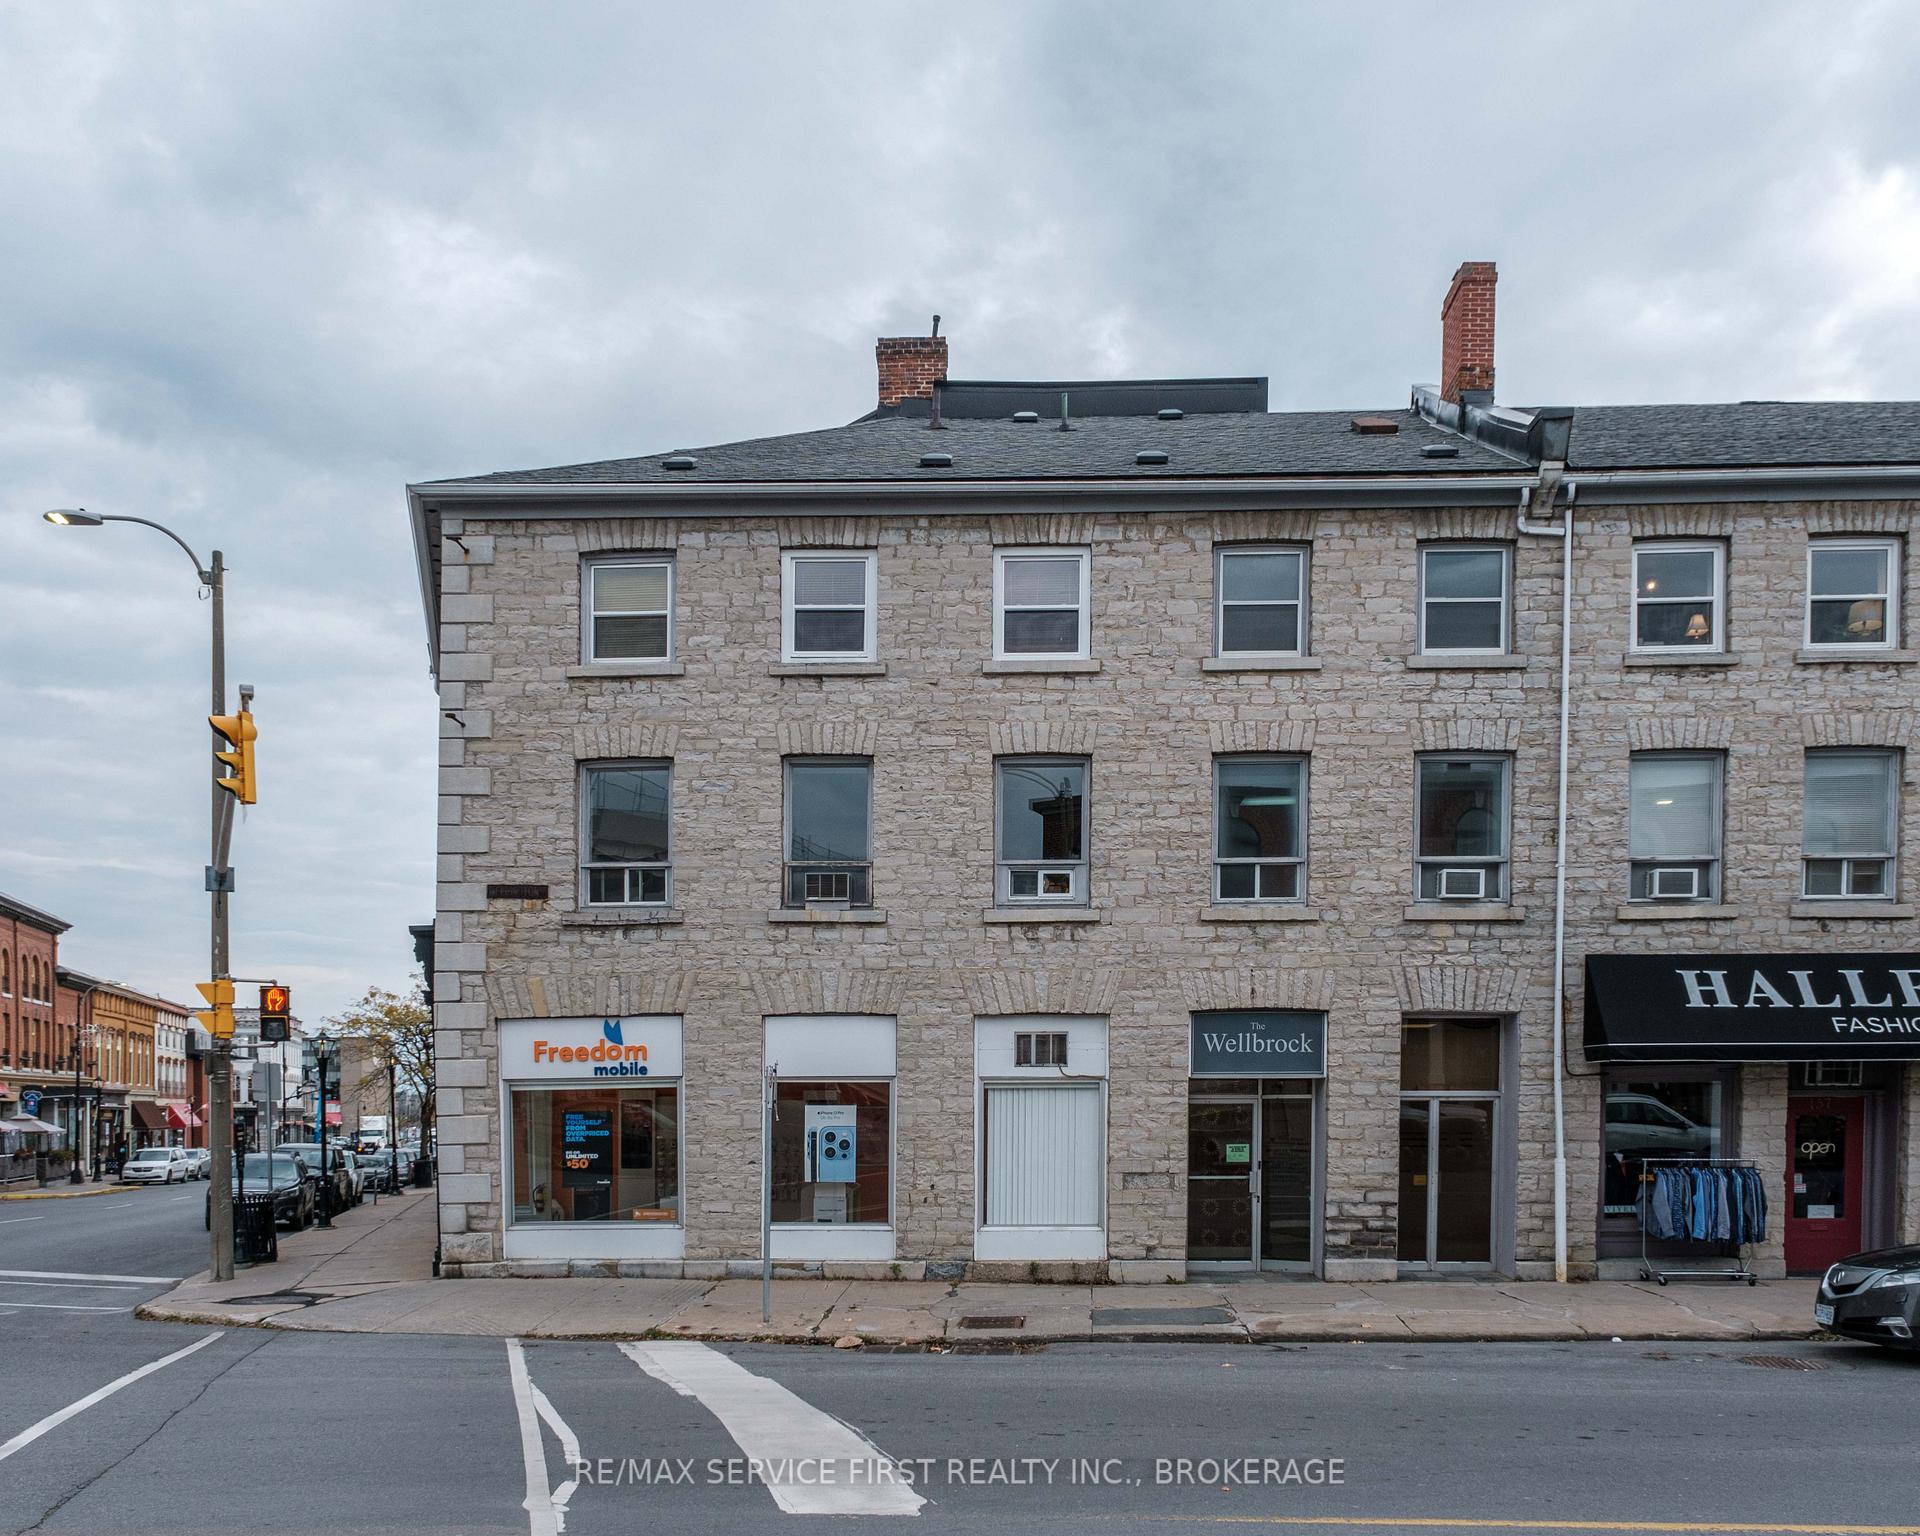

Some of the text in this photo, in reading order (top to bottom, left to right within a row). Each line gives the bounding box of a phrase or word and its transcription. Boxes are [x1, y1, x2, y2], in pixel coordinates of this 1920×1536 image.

[1250, 1022, 1266, 1030] The
[534, 1039, 647, 1063] Freedom
[1203, 1033, 1313, 1053] Wellbrock
[594, 1062, 648, 1076] mobile
[1801, 1142, 1836, 1160] open
[567, 1159, 588, 1169] $50
